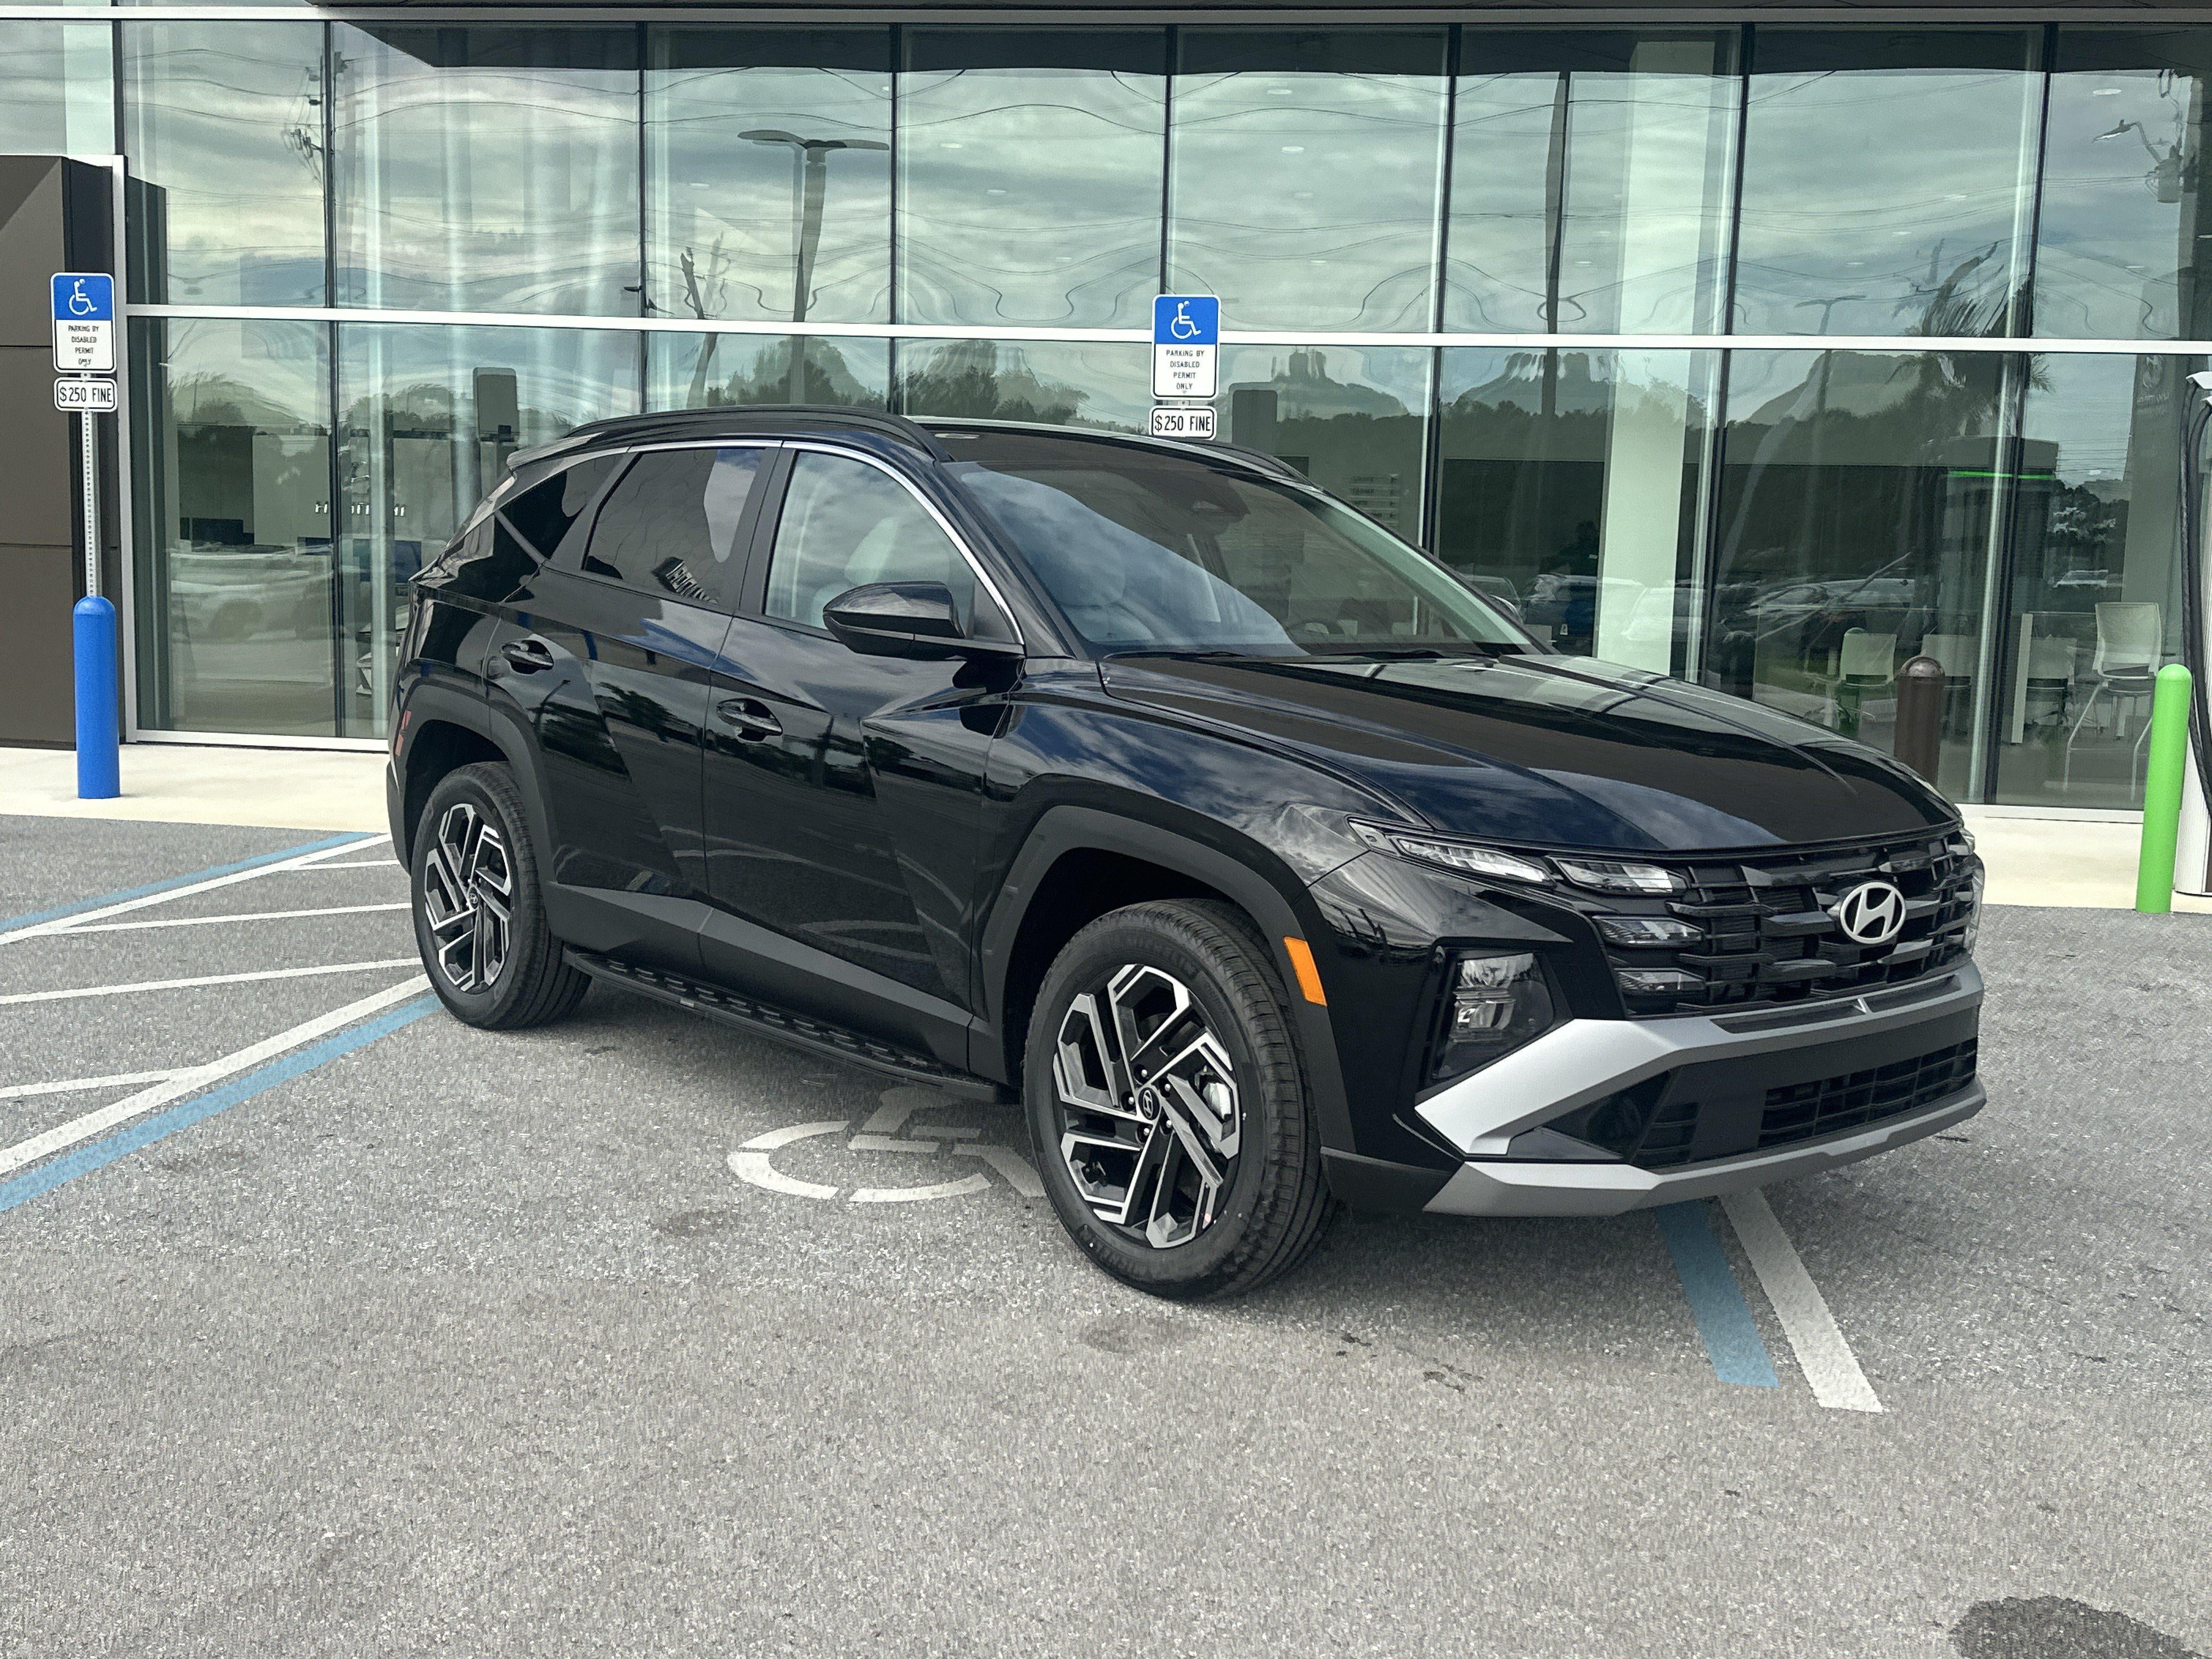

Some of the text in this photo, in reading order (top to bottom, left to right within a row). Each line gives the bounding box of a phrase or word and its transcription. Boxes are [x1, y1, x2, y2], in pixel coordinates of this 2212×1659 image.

[59, 386, 112, 402] $250 FINE
[1154, 414, 1211, 432] $250 FINE
